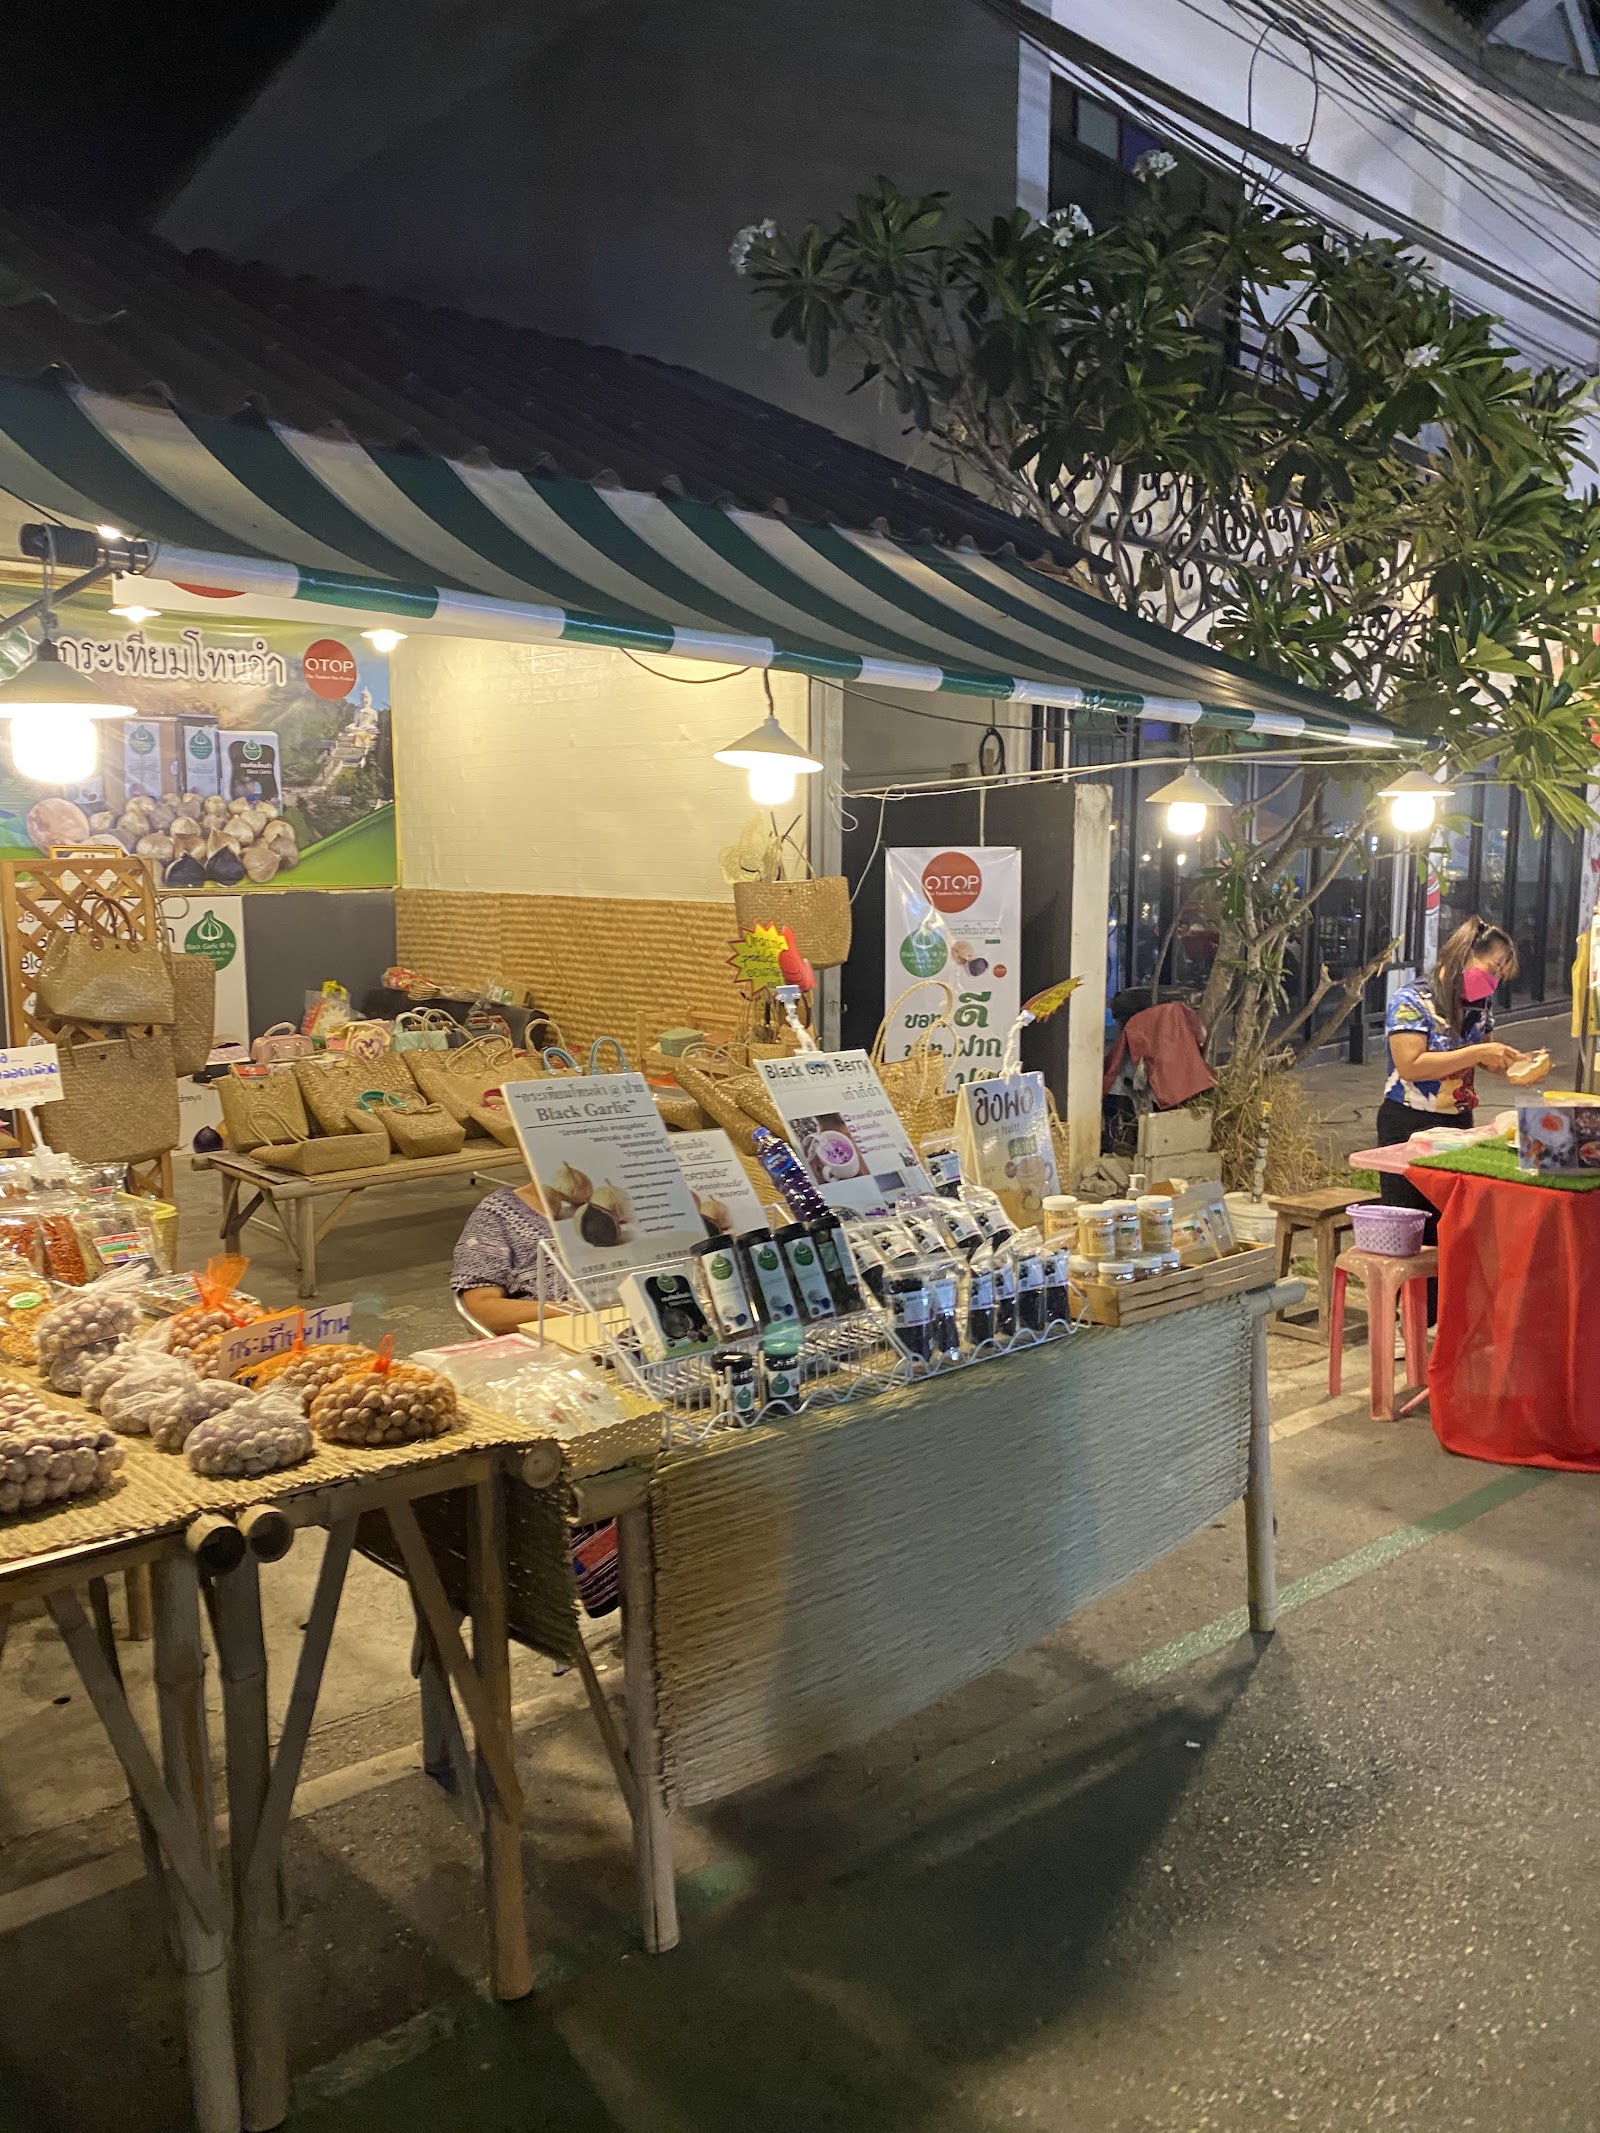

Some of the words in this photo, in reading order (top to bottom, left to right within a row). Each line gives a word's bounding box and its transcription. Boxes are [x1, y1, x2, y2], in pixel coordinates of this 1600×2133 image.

[59, 629, 287, 687] กระเทียมโทนดำ
[304, 657, 355, 673] OTOP
[924, 875, 980, 890] OTOP
[764, 1063, 806, 1081] Black
[835, 1058, 871, 1077] Berry
[608, 1083, 622, 1098] @
[536, 1104, 582, 1123] Black
